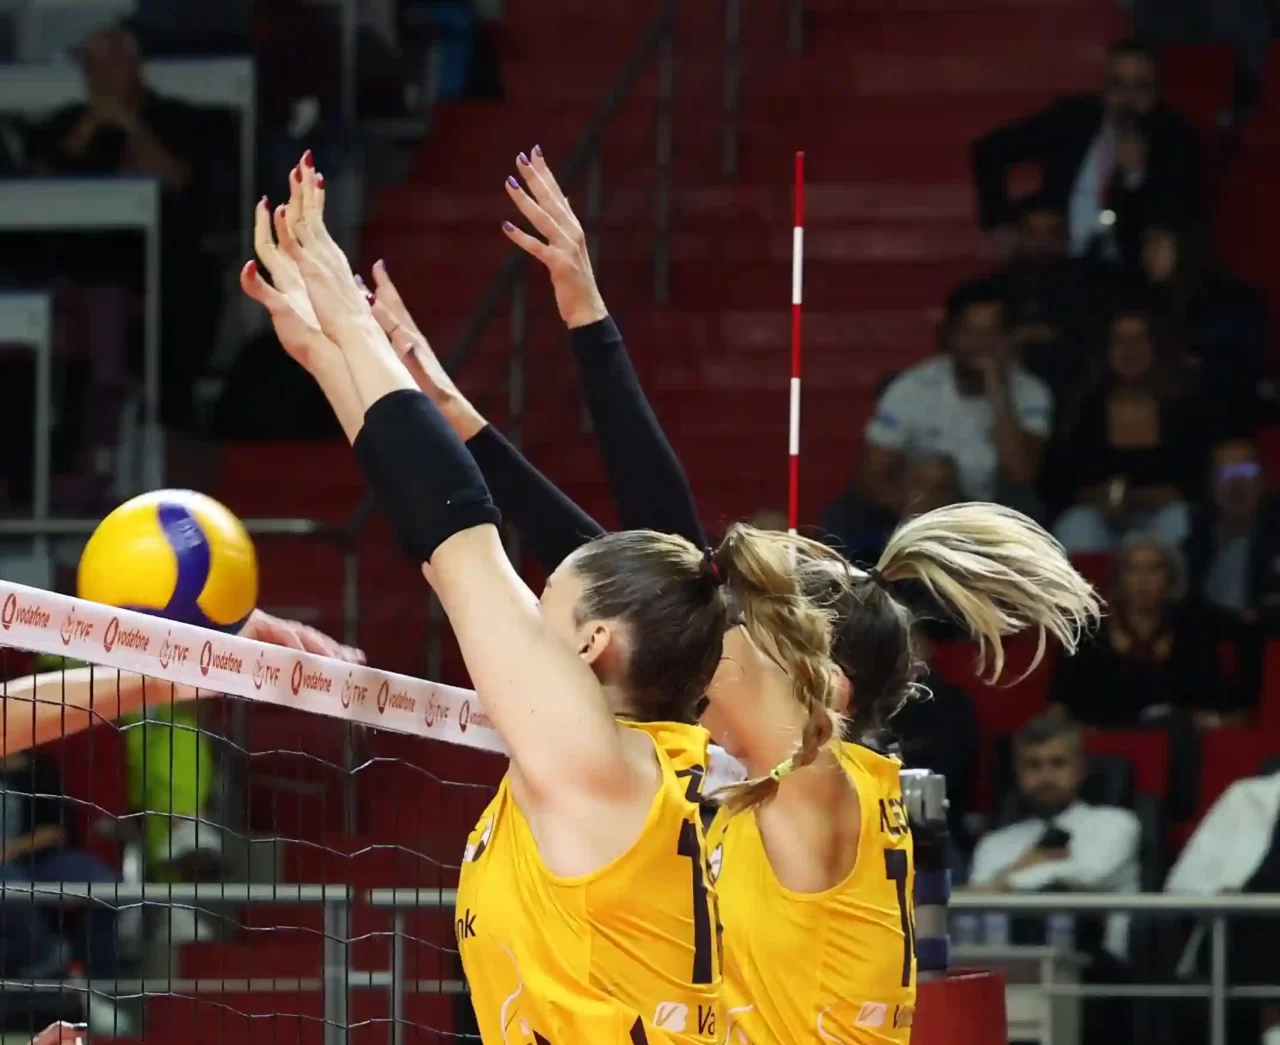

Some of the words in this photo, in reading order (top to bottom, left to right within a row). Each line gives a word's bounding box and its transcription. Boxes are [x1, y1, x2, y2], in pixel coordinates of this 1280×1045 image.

[15, 604, 51, 629] vodafone
[73, 622, 94, 643] TVF
[117, 629, 150, 652] vodafone
[171, 645, 190, 667] TVF
[212, 652, 243, 674] vodafone
[263, 665, 281, 687] TVF
[303, 671, 333, 694] vodafone
[351, 684, 368, 706] TVF
[388, 690, 417, 713] vodafone
